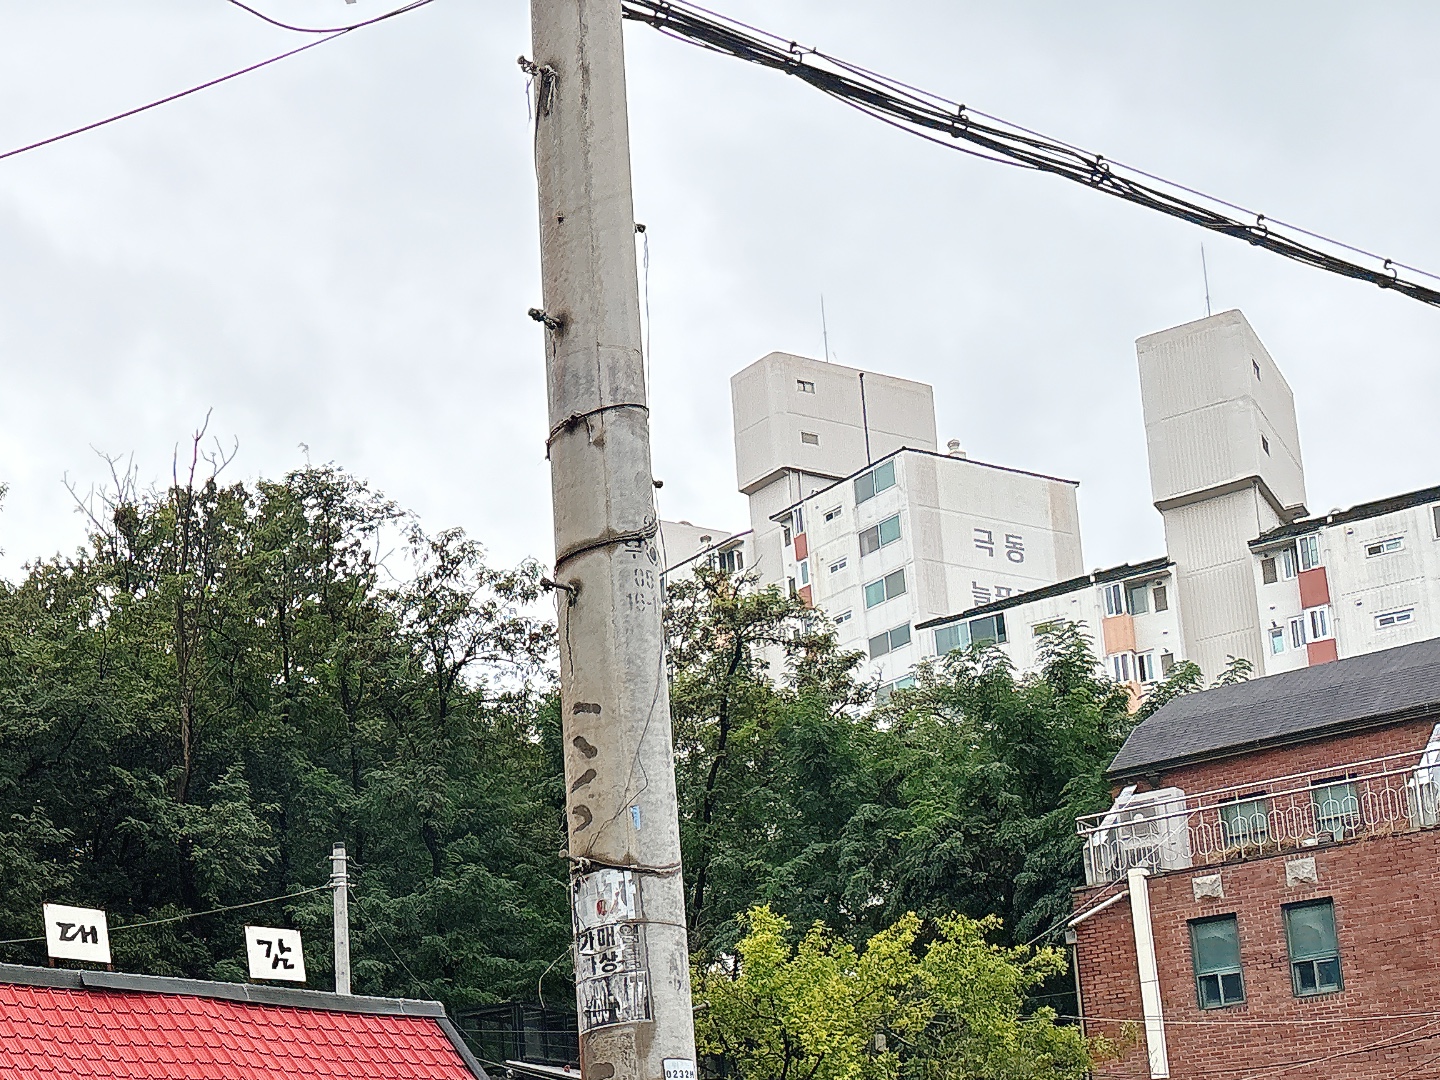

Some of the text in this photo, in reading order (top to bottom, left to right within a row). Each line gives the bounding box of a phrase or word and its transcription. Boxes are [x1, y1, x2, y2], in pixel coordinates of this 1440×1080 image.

[974, 528, 1024, 563] 극동
[56, 921, 98, 945] 대
[256, 938, 295, 969] 감
